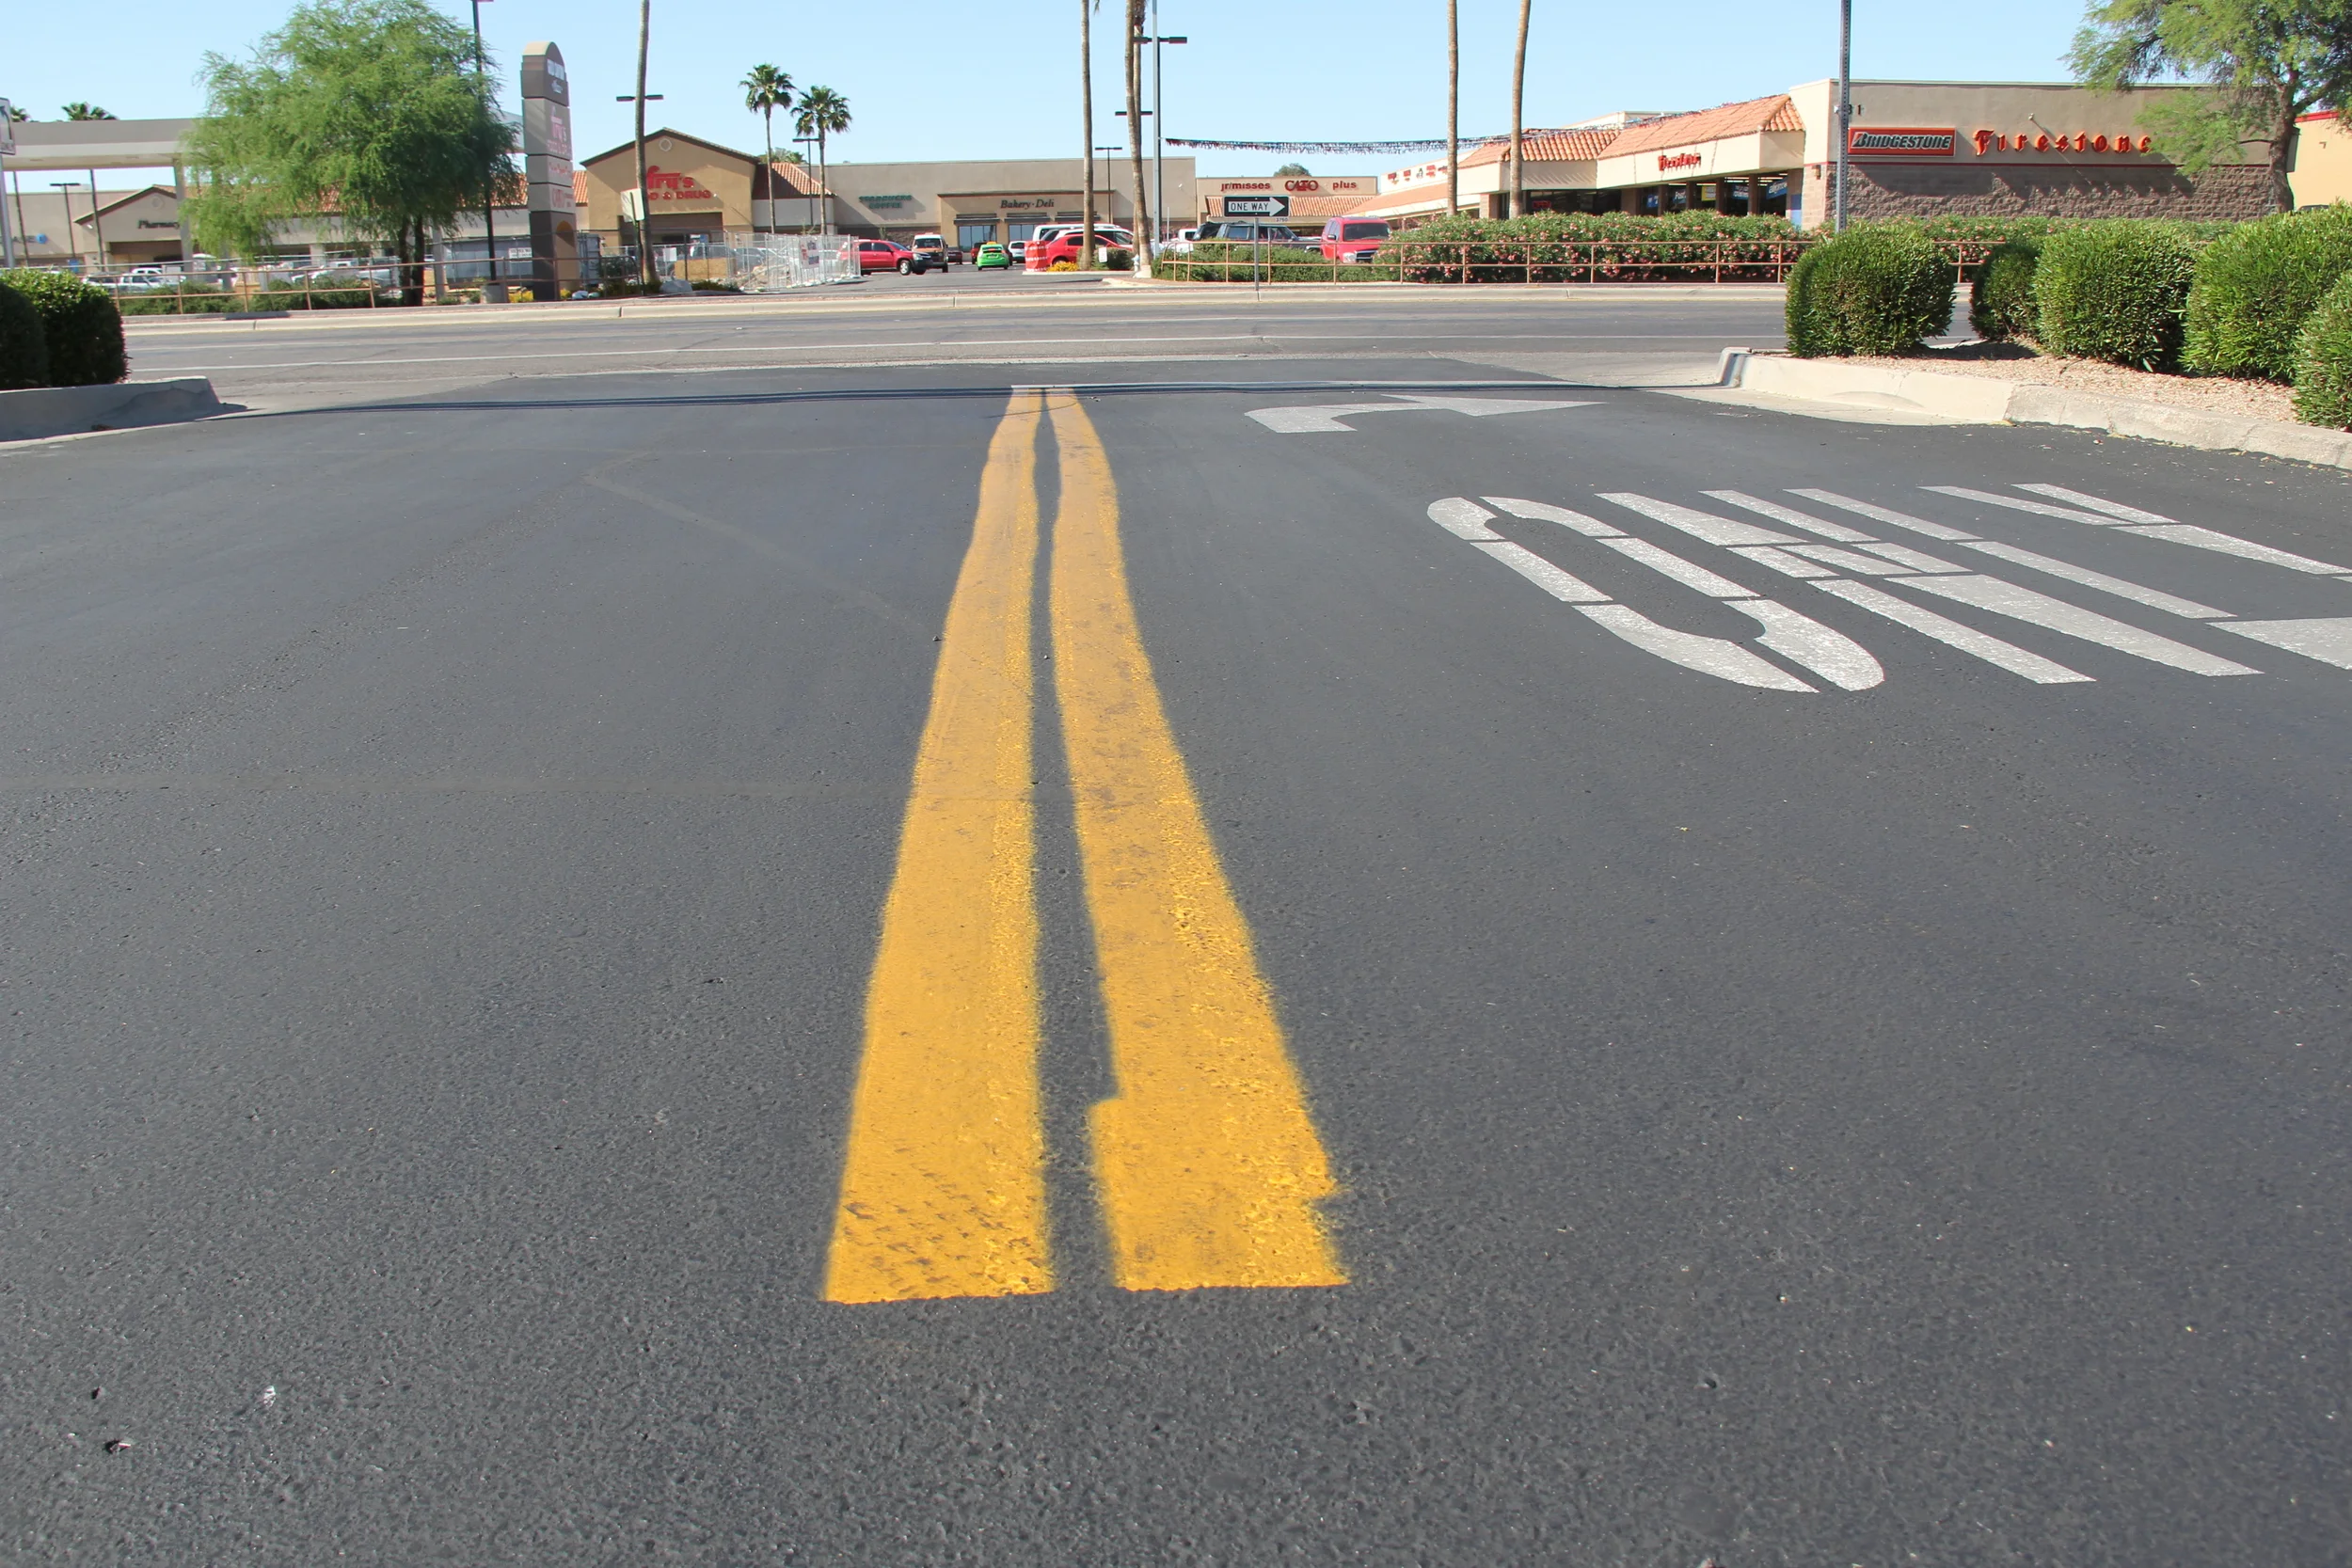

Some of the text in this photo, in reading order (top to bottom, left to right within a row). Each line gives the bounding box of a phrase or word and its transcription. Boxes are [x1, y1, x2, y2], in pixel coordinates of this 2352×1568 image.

[1851, 132, 1951, 150] BRIDGESTONE
[1973, 129, 2153, 156] Firestone
[1285, 180, 1319, 192] CATO
[1333, 181, 1358, 190] plus
[676, 190, 711, 199] DRUG
[1231, 201, 1269, 212] ONE WAY
[138, 219, 181, 230] Pharmacy
